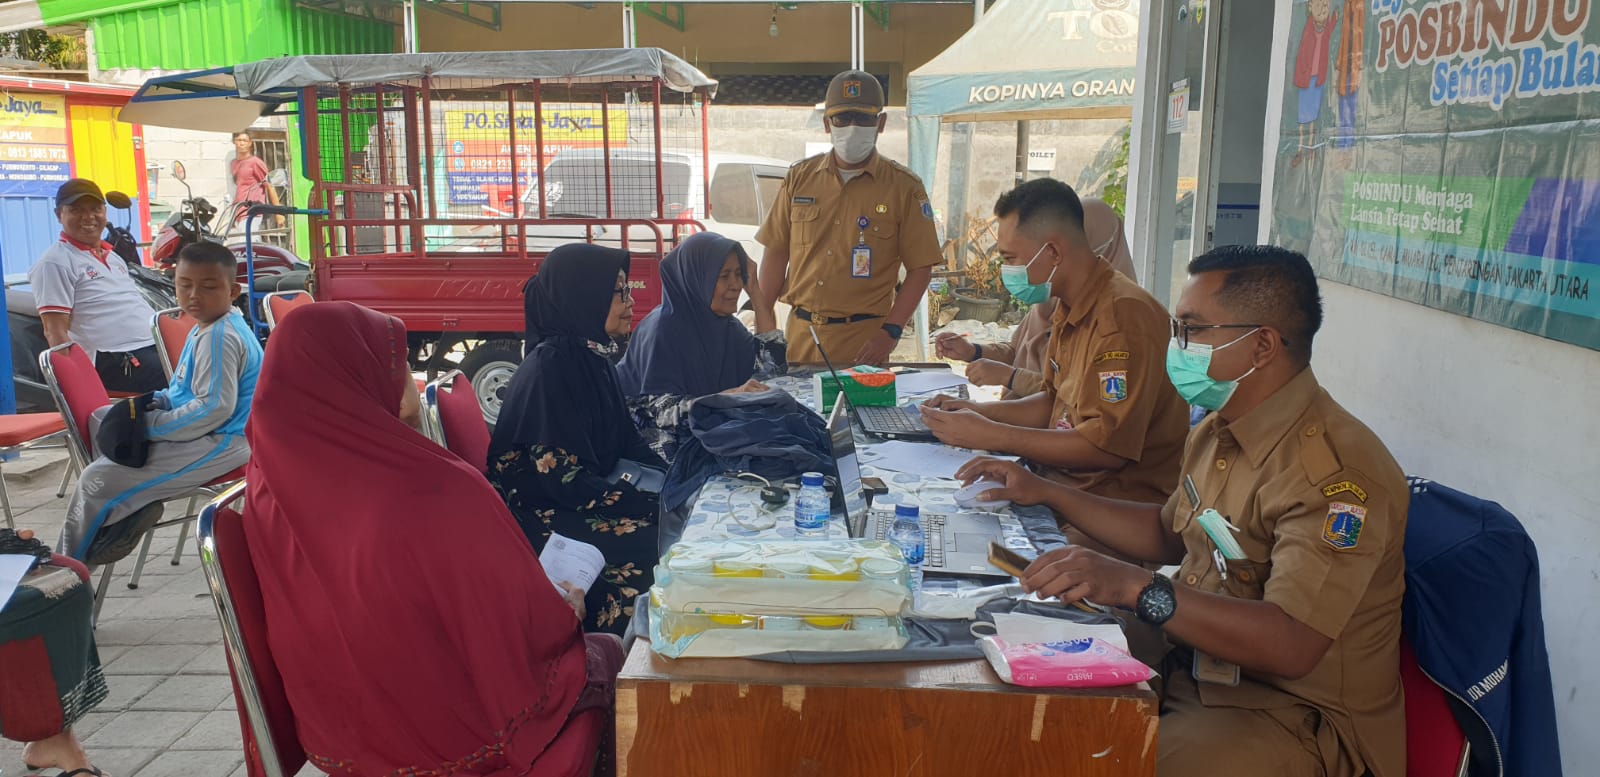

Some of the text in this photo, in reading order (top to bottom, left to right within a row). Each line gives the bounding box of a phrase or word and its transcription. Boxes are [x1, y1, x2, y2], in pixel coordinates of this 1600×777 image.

[1376, 0, 1590, 69] POSBINDU
[968, 77, 1136, 104] KOPINYA ORAN
[1431, 57, 1513, 105] Setiap
[5, 95, 42, 117] Jaya
[1172, 95, 1184, 120] 112
[0, 130, 33, 140] APUK
[548, 112, 593, 133] Jaya
[1352, 182, 1474, 213] POSBINDU Menjaga
[1350, 204, 1464, 236] Lansia Tetap Sehat
[1066, 672, 1093, 681] PASEO
[1467, 684, 1485, 703] UR
